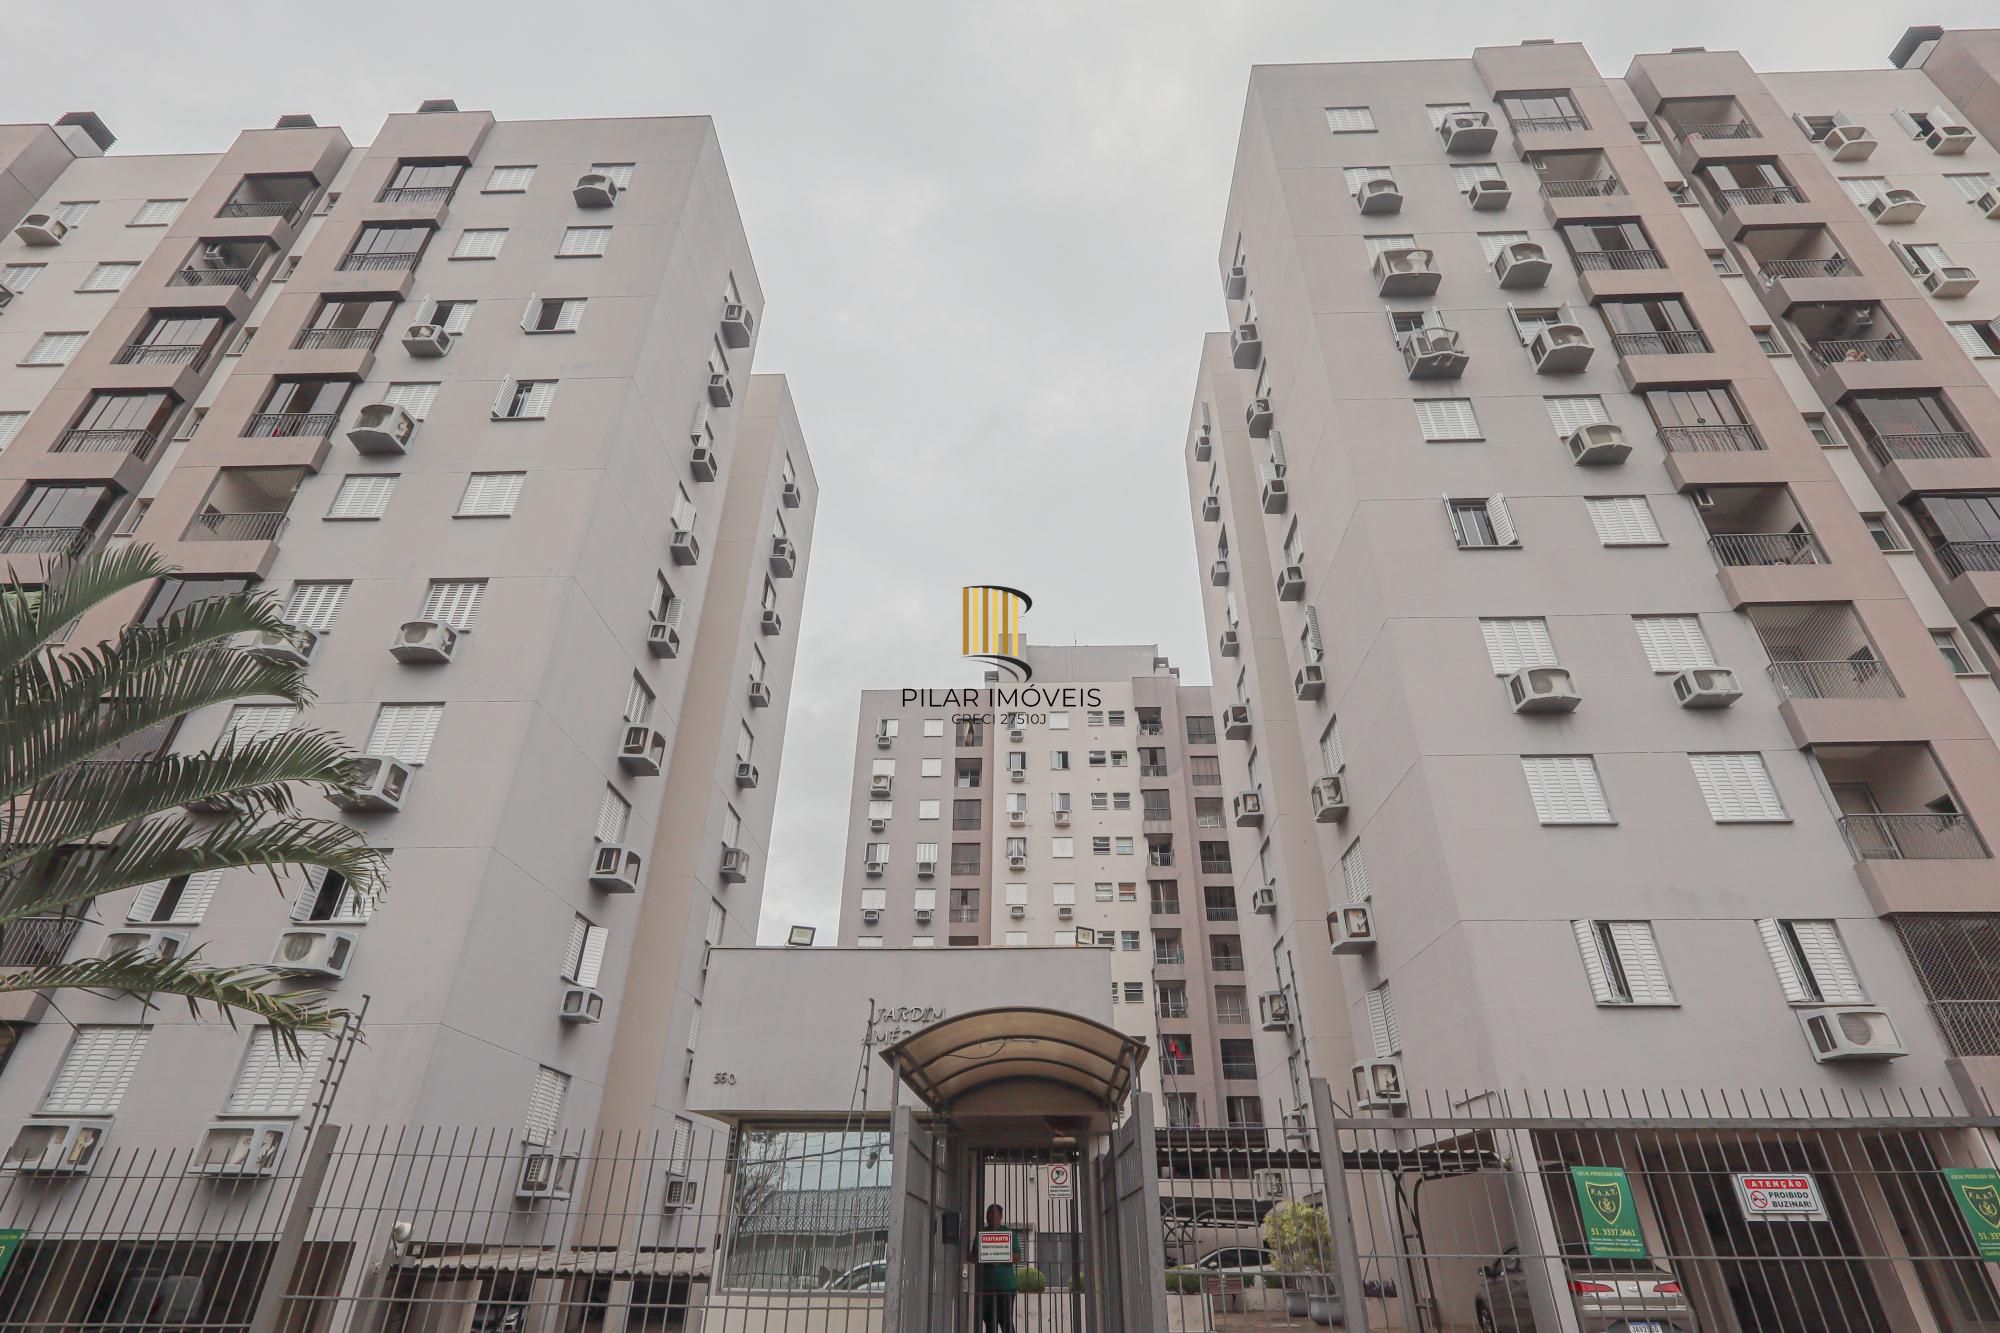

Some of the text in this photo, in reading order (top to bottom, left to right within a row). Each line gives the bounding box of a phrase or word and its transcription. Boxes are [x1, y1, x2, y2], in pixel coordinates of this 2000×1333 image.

[1751, 1180, 1802, 1189] ATENÇÃO
[1768, 1191, 1809, 1199] PROIBIDO
[1772, 1200, 1813, 1208] BUZINAR!
